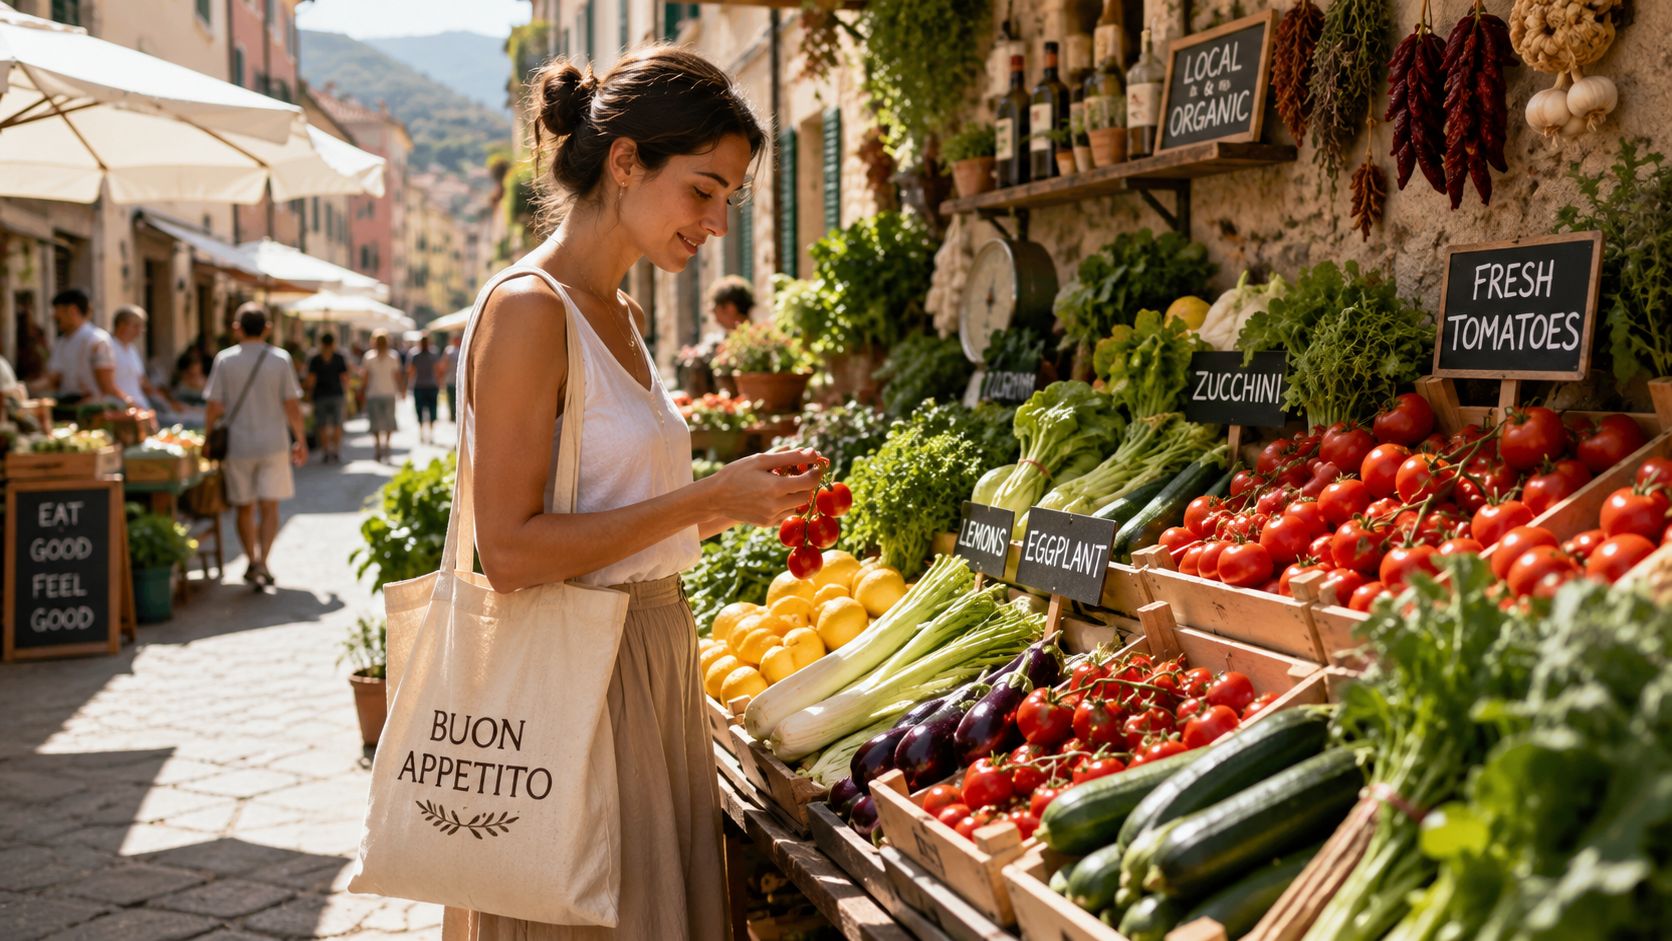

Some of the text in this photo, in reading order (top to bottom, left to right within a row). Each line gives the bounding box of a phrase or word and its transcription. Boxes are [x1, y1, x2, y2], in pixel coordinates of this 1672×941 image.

[1183, 41, 1242, 84] LOCAL
[1169, 90, 1250, 137] ORGANIC
[1473, 259, 1555, 300] FRESH
[1447, 311, 1580, 351] TOMATOES
[1192, 371, 1282, 404] ZUCCHINI
[38, 501, 85, 528] EAT
[30, 536, 93, 562] GOOD
[958, 518, 1007, 557] LEMONS
[1024, 530, 1107, 578] EGGPLANT
[32, 573, 88, 599] FEEL
[30, 606, 95, 633] GOOD
[430, 709, 526, 751] BUON
[397, 750, 553, 800] APPETITO
